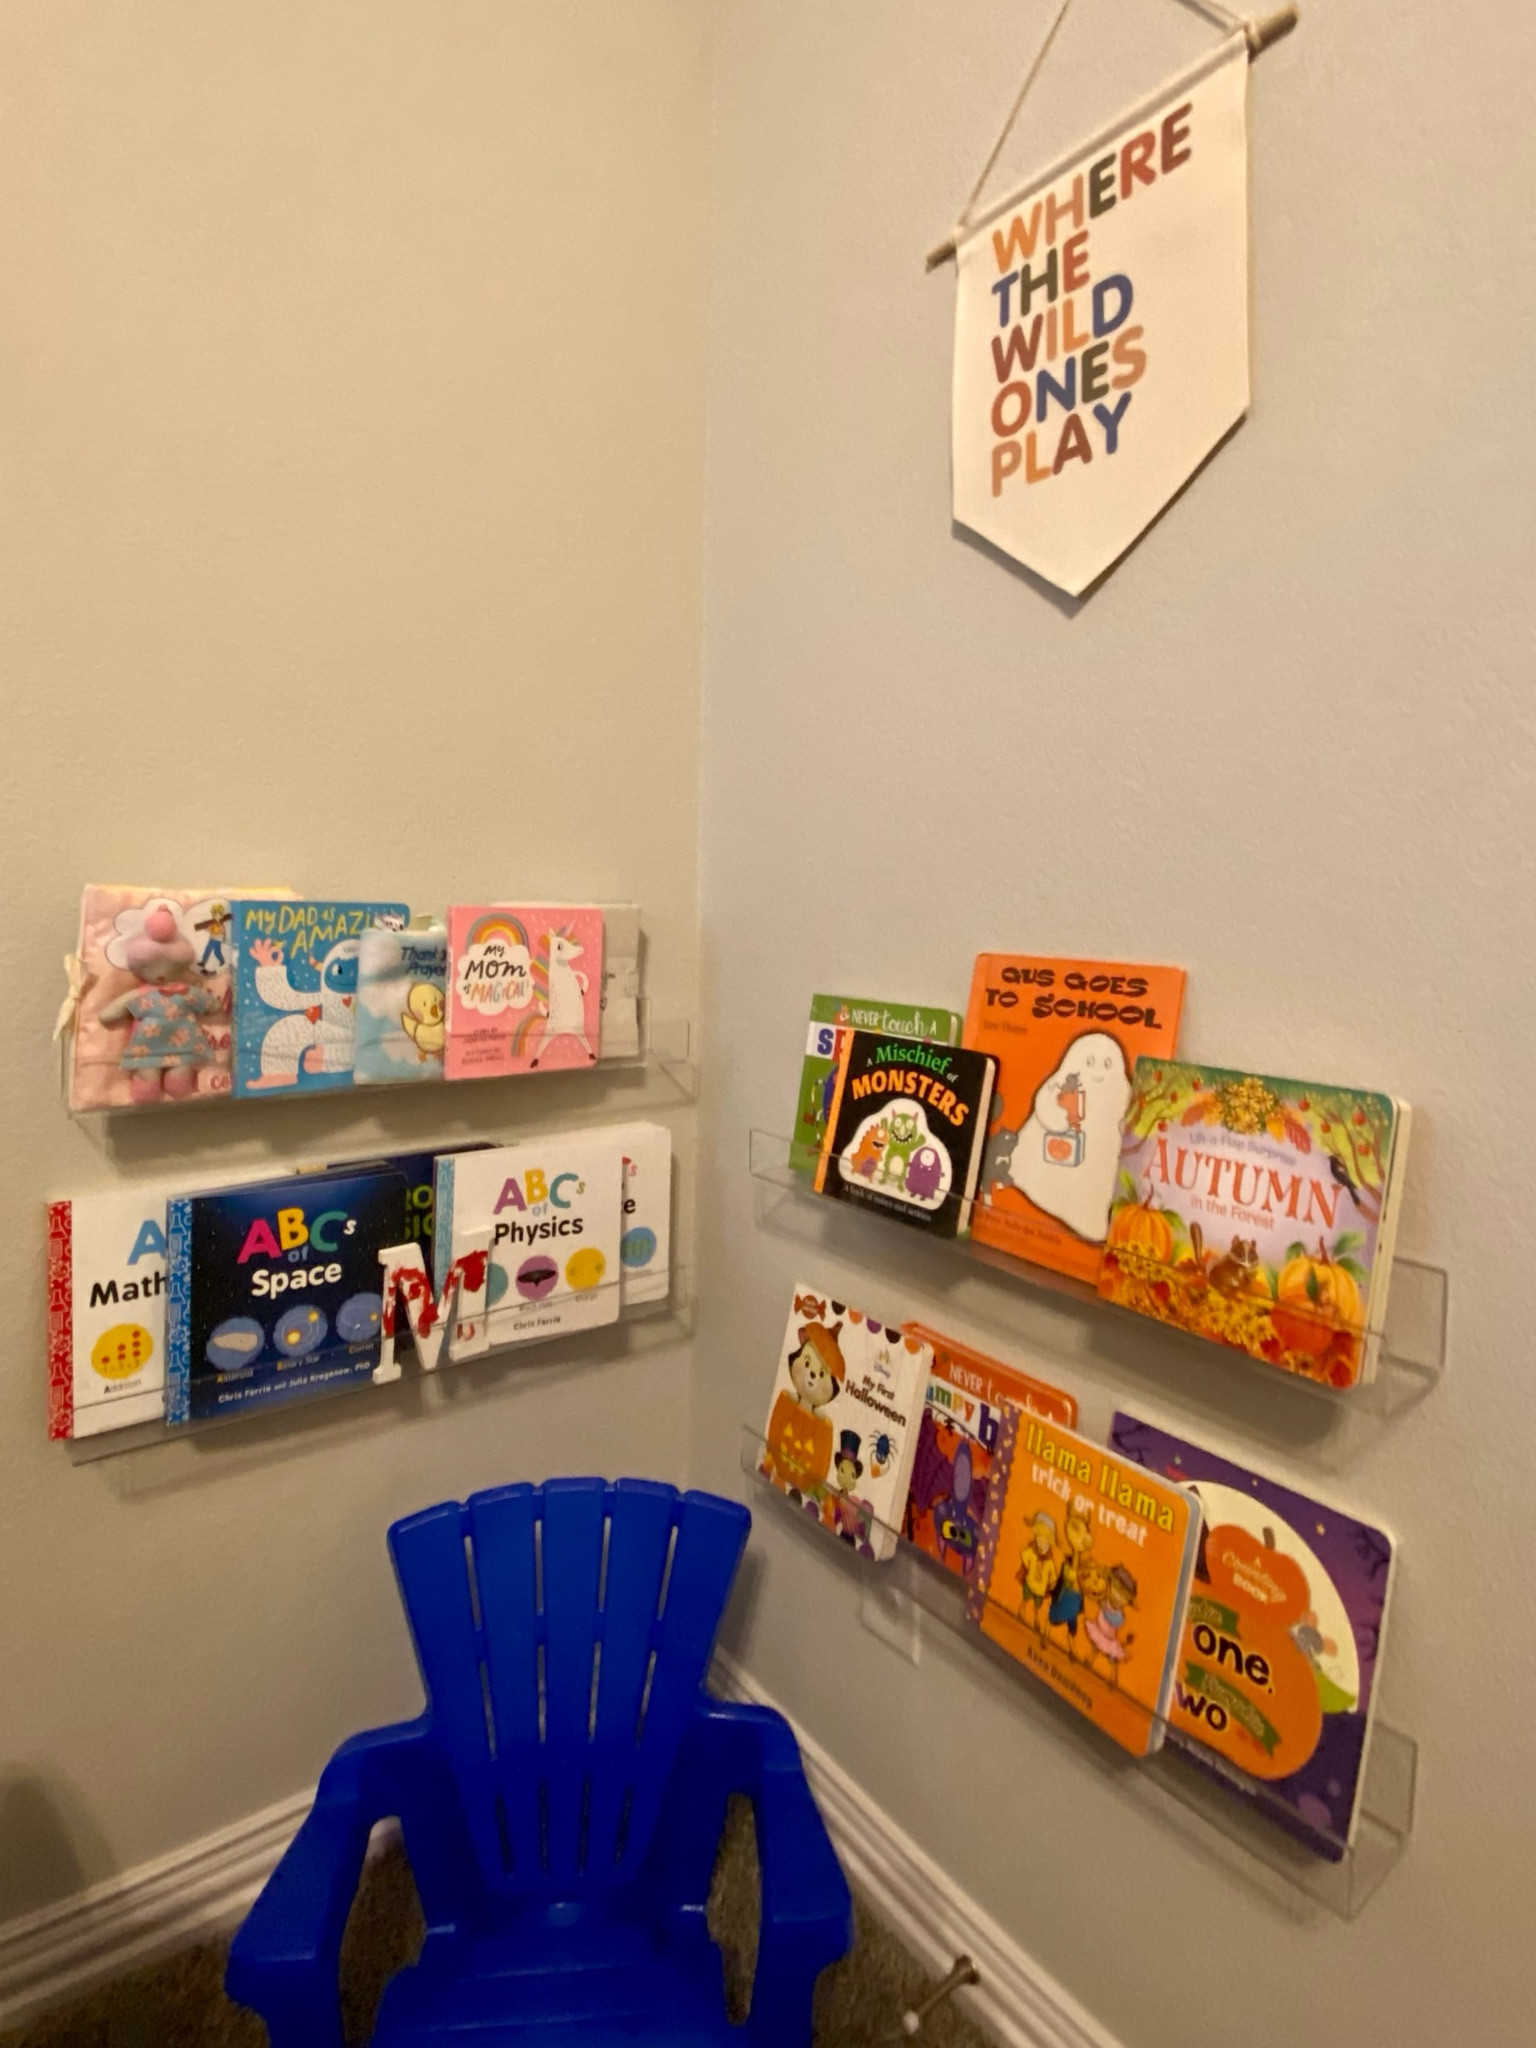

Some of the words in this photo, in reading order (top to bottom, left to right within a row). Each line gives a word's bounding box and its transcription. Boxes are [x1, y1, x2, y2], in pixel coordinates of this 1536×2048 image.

[992, 102, 1193, 274] WHERE
[991, 230, 1090, 328] THE
[991, 273, 1134, 384] WILD
[991, 325, 1147, 438] ONES
[991, 391, 1133, 498] PLAY
[278, 904, 318, 934] DAD
[985, 987, 1019, 1009] TO
[1031, 993, 1162, 1030] SCHOOL
[1064, 972, 1149, 998] GOES
[851, 1008, 880, 1027] NEVER
[880, 1009, 927, 1036] touch
[929, 1020, 937, 1036] A
[866, 1057, 873, 1067] A
[875, 1042, 953, 1075] Mischief
[946, 1072, 959, 1083] of
[851, 1069, 970, 1127] MONSTERS
[1143, 1136, 1344, 1230] AUTUMN
[494, 1217, 583, 1246] Physics
[532, 1201, 548, 1217] of
[288, 1246, 308, 1262] of
[251, 1262, 342, 1299] Space
[950, 1362, 982, 1394] NEVER
[845, 1379, 906, 1427] Halloween
[1025, 1422, 1093, 1485] llama
[1098, 1463, 1175, 1534] llama
[1032, 1462, 1072, 1502] trick
[1073, 1492, 1095, 1517] or
[1098, 1502, 1148, 1548] treat
[1173, 1680, 1228, 1732] wo
